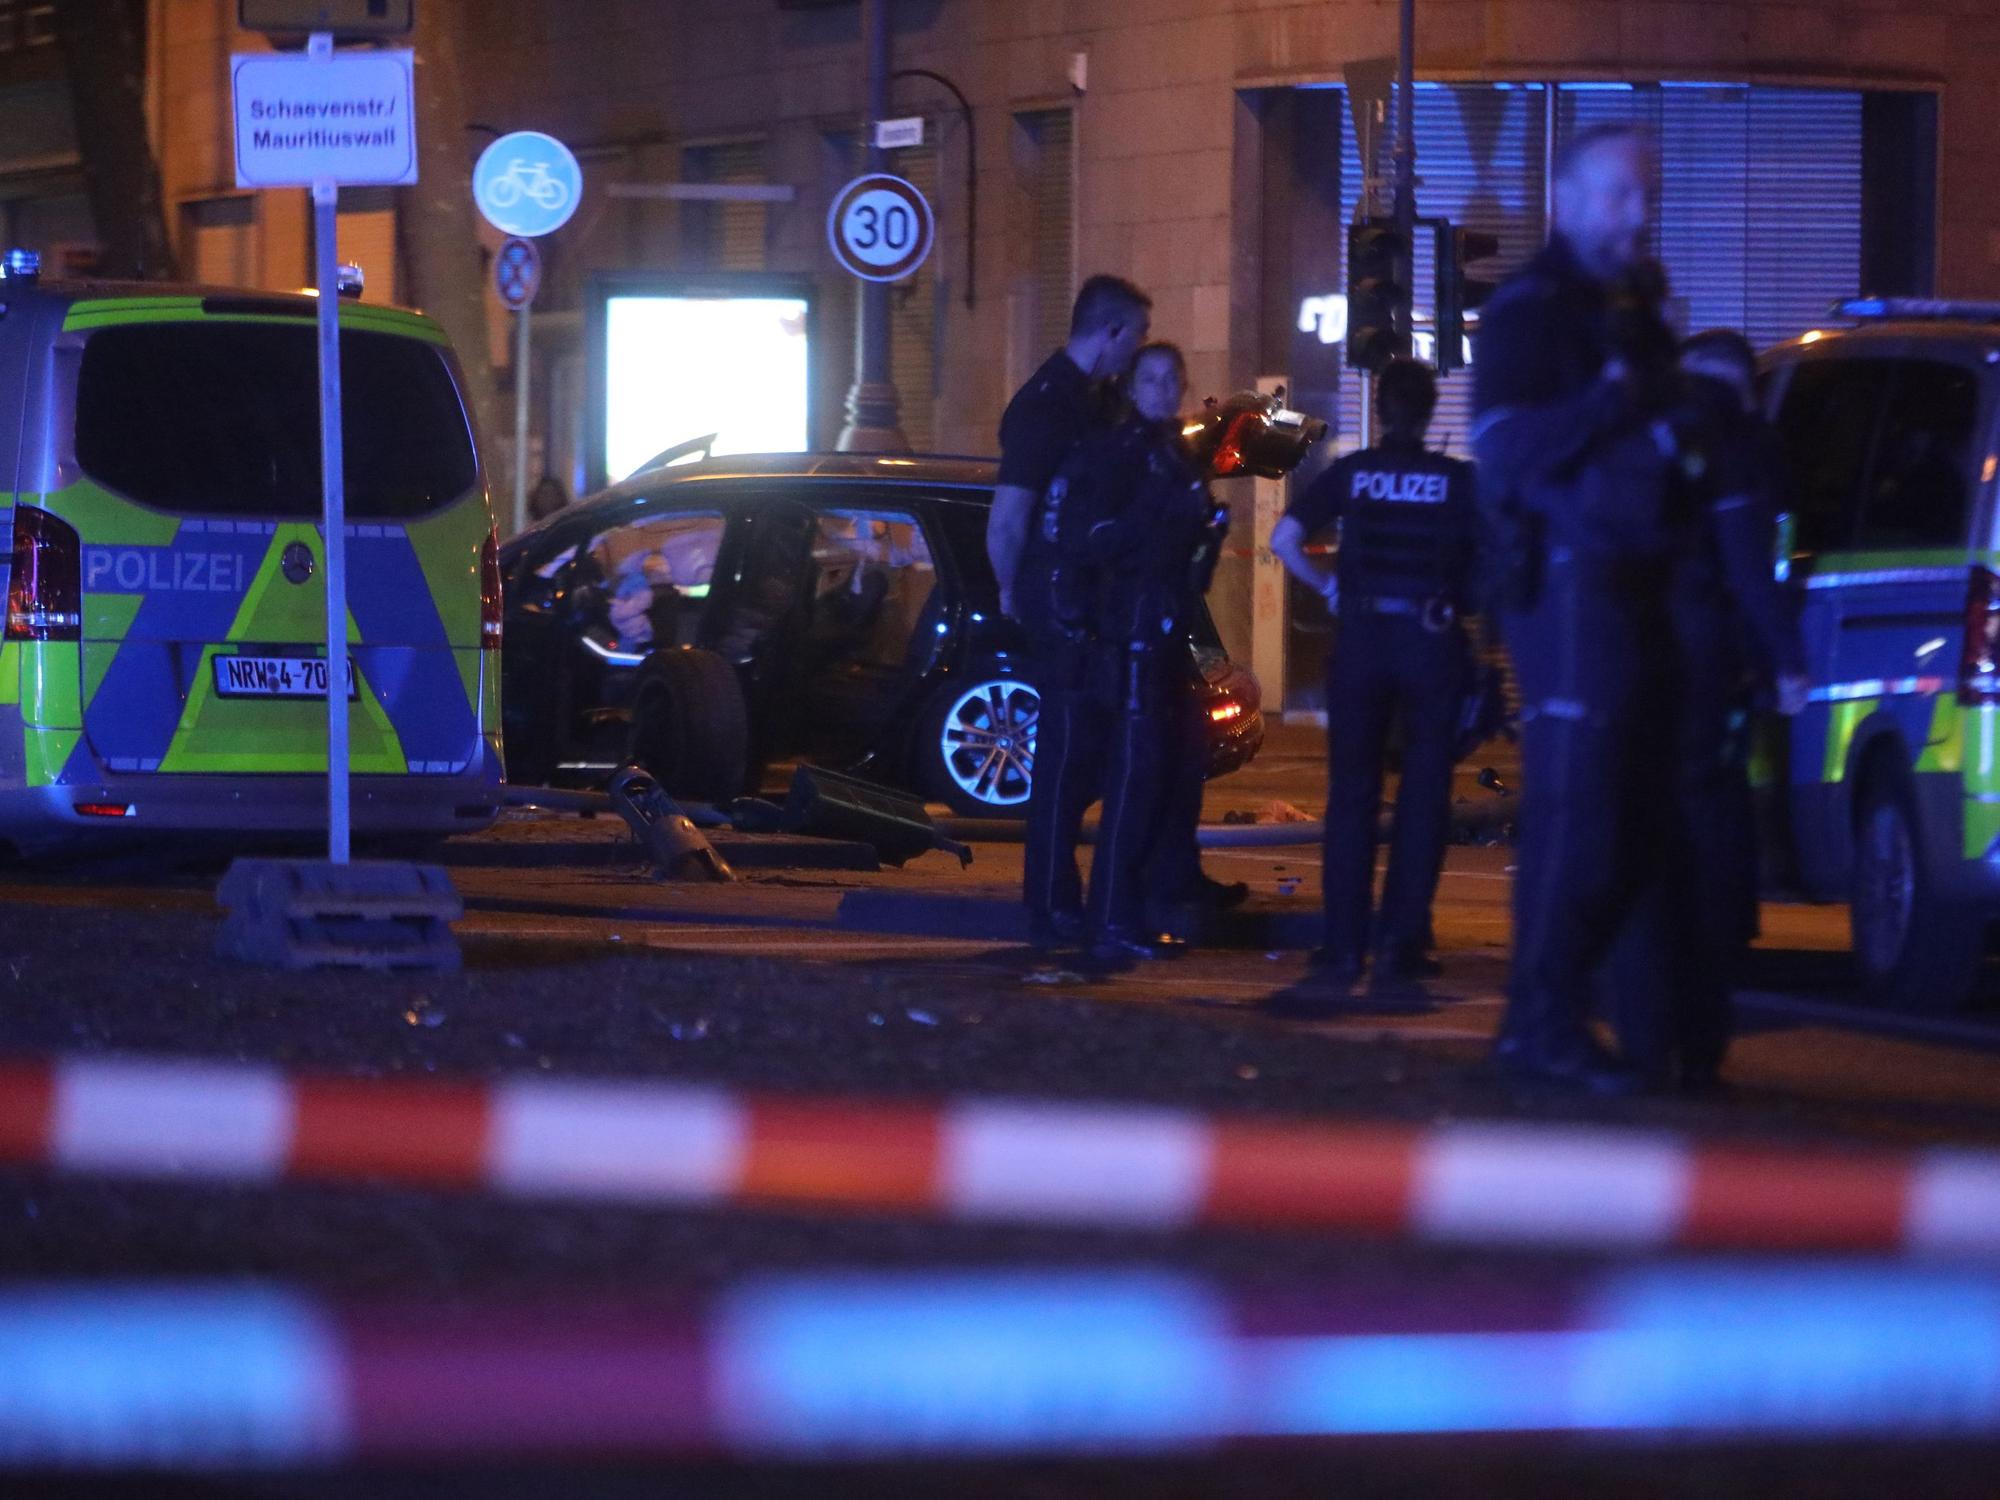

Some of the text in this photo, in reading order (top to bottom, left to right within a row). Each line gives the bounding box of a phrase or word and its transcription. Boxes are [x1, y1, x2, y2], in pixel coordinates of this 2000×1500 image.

[253, 127, 396, 150] Mauritiuswall
[855, 205, 910, 249] 30
[1352, 471, 1448, 502] POLIZEI
[87, 551, 244, 592] POLIZEI
